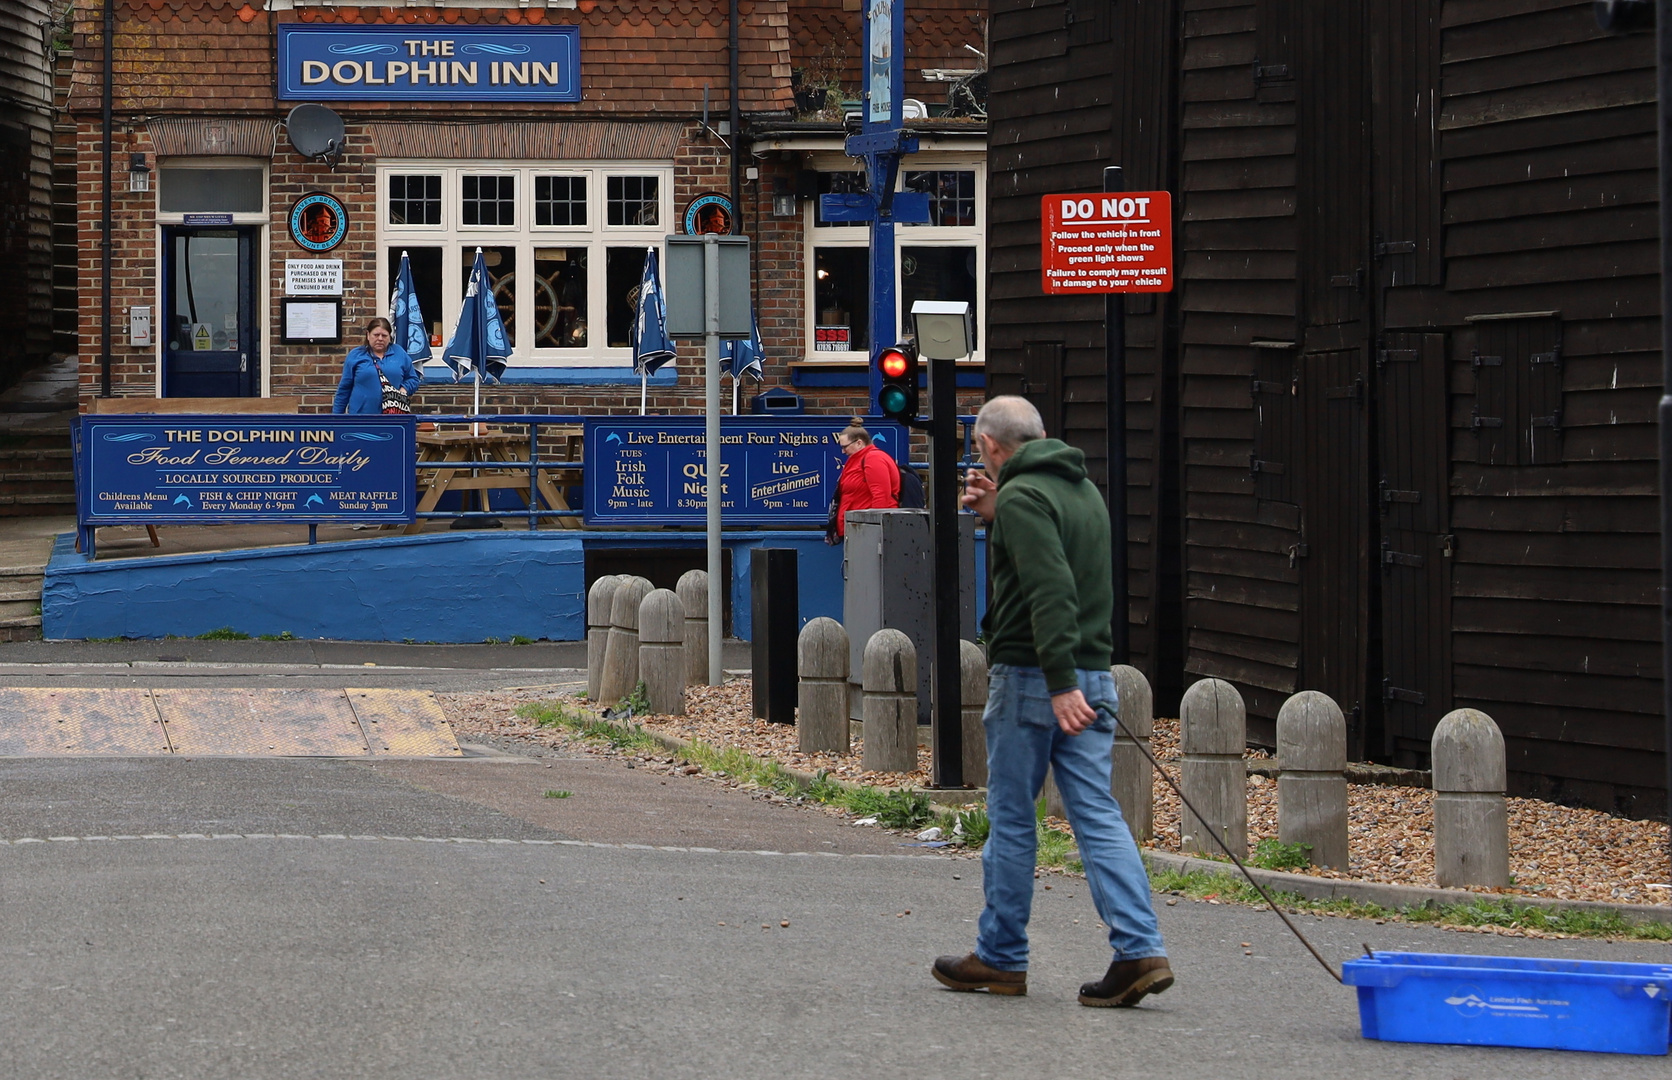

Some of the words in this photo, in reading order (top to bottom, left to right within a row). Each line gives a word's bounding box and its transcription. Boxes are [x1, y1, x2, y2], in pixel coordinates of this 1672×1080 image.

[404, 40, 456, 56] THE
[301, 60, 478, 85] DOLPHIN
[490, 61, 559, 85] INN
[320, 197, 344, 220] BREWERY
[1062, 199, 1094, 219] DO
[1102, 198, 1150, 218] NOT
[294, 228, 302, 237] WE
[301, 238, 320, 249] WUNT
[1095, 244, 1113, 253] only
[1095, 255, 1114, 264] light
[1089, 268, 1119, 277] comply
[1063, 279, 1096, 288] damage
[1110, 279, 1128, 288] your
[165, 430, 202, 442] THE
[208, 430, 294, 442] DOLPHIN
[300, 430, 334, 442] INN
[628, 432, 654, 444] Live
[658, 432, 743, 444] Entertaient
[748, 432, 775, 444] Four
[779, 432, 818, 446] Nights
[127, 447, 200, 465] Food
[204, 446, 294, 465] Served
[296, 446, 370, 471] Daily
[616, 461, 646, 472] Irish
[683, 464, 729, 479] QUZ
[773, 462, 799, 474] Live
[166, 474, 218, 483] LOCALLY
[222, 474, 275, 483] SOURCED
[280, 474, 332, 483] PRODUCE
[617, 473, 645, 484] Folk
[612, 486, 650, 497] Music
[684, 483, 728, 497] Nigt
[752, 474, 820, 498] Entertainment
[99, 492, 141, 500] Childrens
[200, 492, 222, 500] FISH
[226, 492, 234, 500] &
[236, 492, 262, 500] CHIP
[265, 492, 298, 500] NIGHT
[330, 492, 357, 500] MEAT
[360, 492, 398, 500] RAFFLE
[114, 502, 152, 510] Available
[202, 502, 226, 511] Every
[229, 502, 262, 511] Monday
[339, 502, 368, 511] Sunday
[371, 502, 388, 511] 3pm
[608, 499, 627, 508] 9pm
[638, 499, 653, 507] late
[764, 499, 782, 509] 9pm
[793, 499, 808, 507] late
